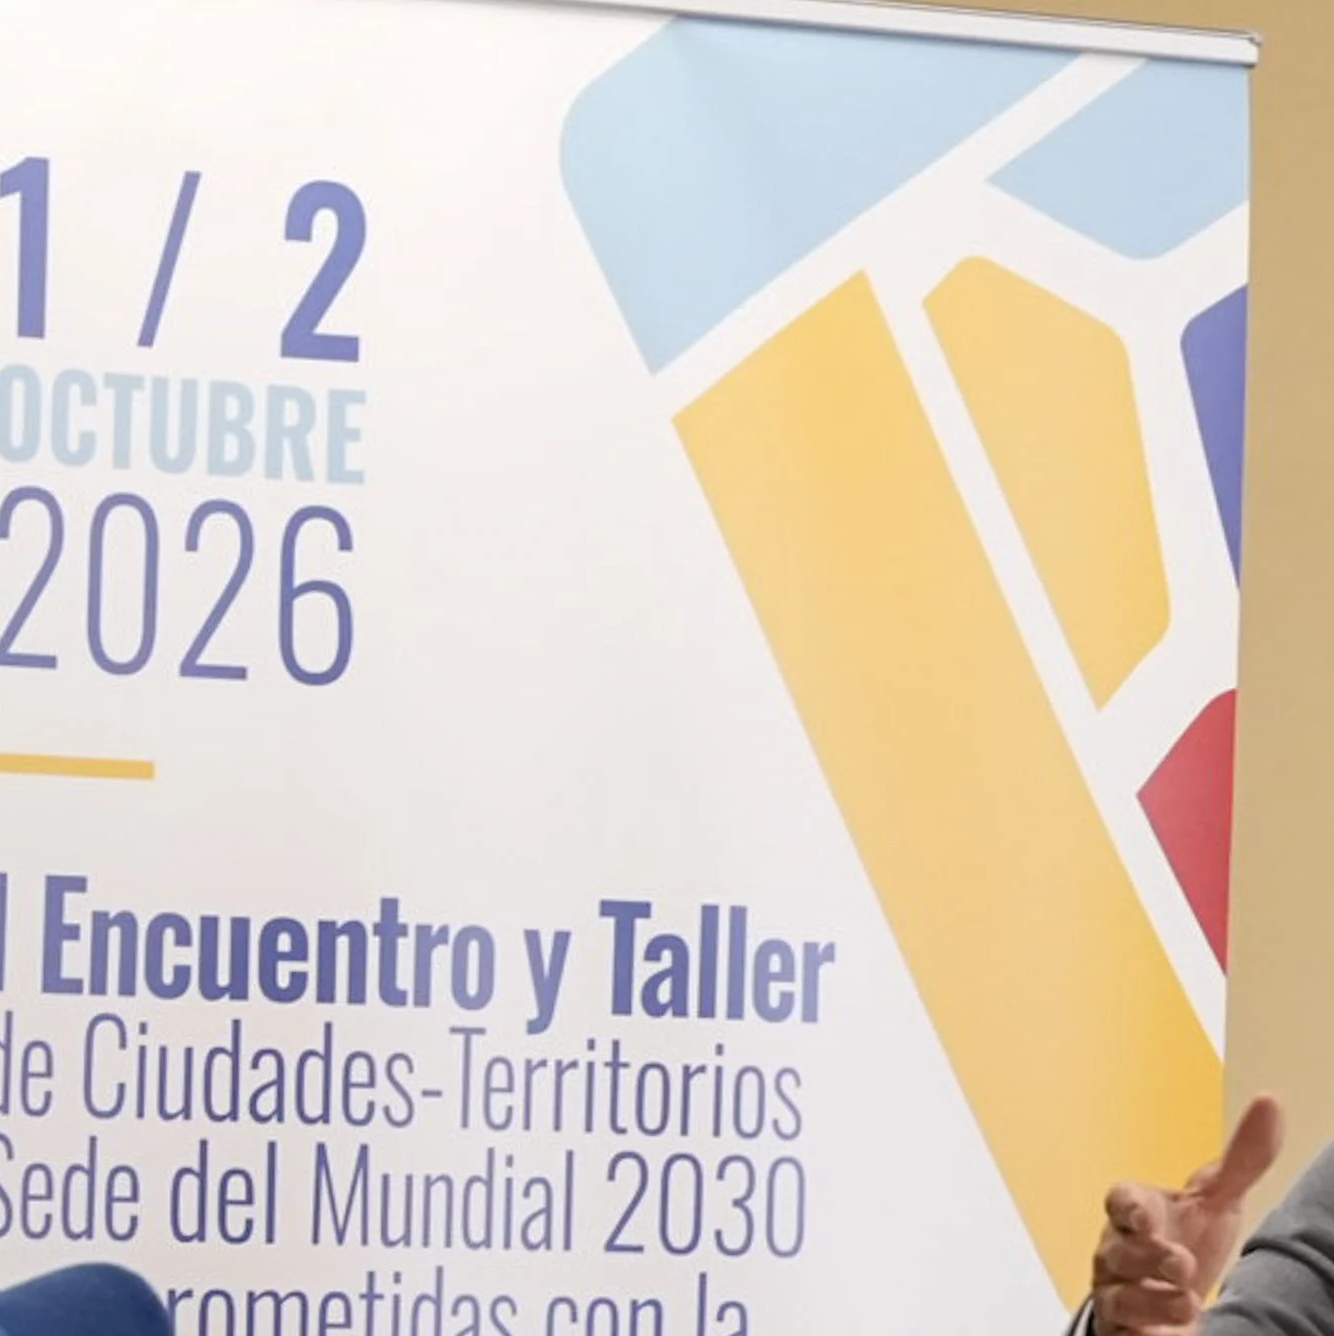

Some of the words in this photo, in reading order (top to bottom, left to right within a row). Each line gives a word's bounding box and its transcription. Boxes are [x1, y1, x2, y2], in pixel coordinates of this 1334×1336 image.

[136, 170, 202, 349] /
[279, 179, 367, 363] 2
[41, 874, 496, 1010] Encuentro
[522, 928, 572, 1035] y
[597, 898, 836, 1024] Taller
[82, 1012, 804, 1141] Ciudades-Territorios
[169, 1138, 278, 1246] del
[310, 1141, 575, 1253] Mundial
[602, 1150, 807, 1259] 2030
